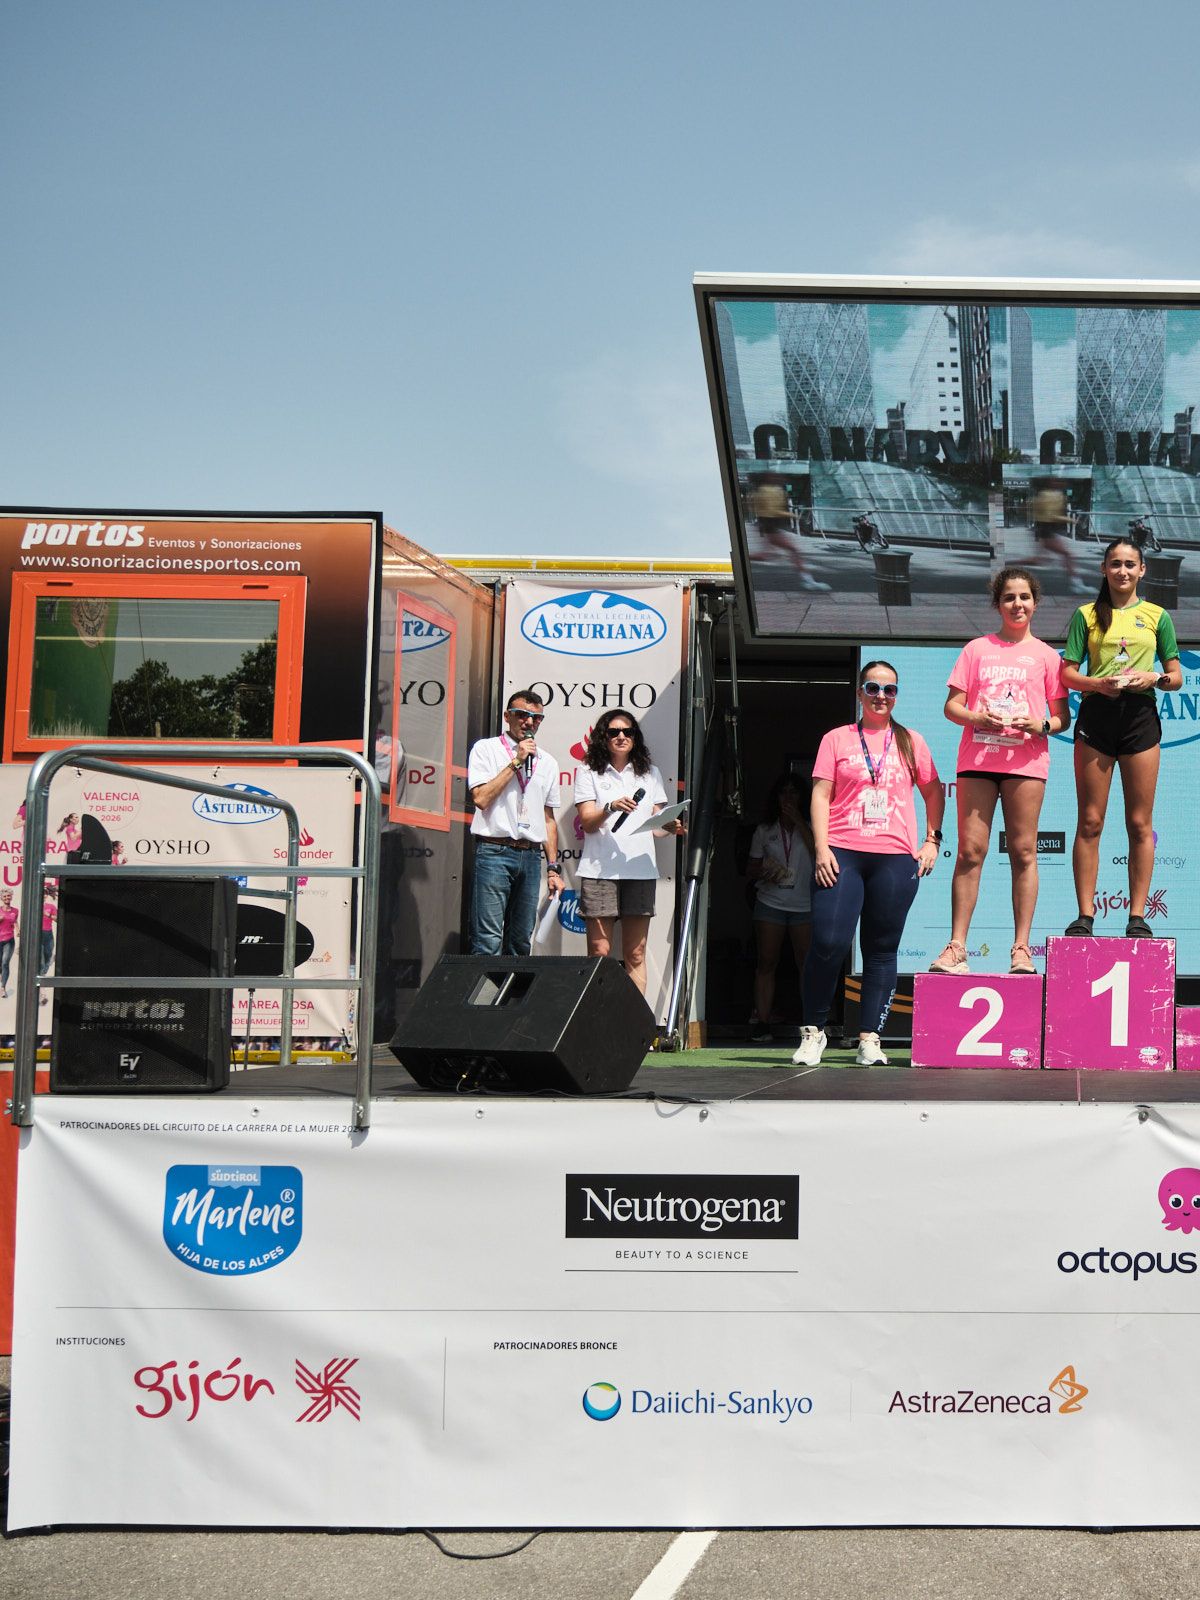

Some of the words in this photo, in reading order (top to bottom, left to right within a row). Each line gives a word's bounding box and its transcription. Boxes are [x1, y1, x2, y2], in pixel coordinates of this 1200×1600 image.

[753, 424, 974, 464] CANARY
[21, 521, 146, 550] portos
[148, 537, 196, 549] Eventos
[199, 540, 207, 551] y
[210, 538, 302, 550] Sonorizaciones
[20, 555, 301, 572] www.sonorizacionesportos.com
[555, 612, 601, 621] CENTRAL
[605, 613, 652, 622] LECHERA
[531, 613, 656, 640] ASTURIANA
[980, 665, 1027, 682] CARRERA
[527, 681, 657, 709] OYSHO
[83, 792, 140, 802] VALENCIA
[89, 805, 94, 813] 7
[109, 805, 134, 813] JUNIO
[101, 814, 122, 822] 2026
[135, 839, 210, 856] OYSHO
[273, 849, 334, 860] Saander
[81, 1000, 185, 1021] portos
[292, 1001, 315, 1010] OSA
[1091, 961, 1130, 1047] 1
[956, 986, 1004, 1057] 2
[120, 1053, 140, 1071] EV
[60, 1121, 141, 1131] PATROCINADORES
[143, 1123, 160, 1131] DEL
[162, 1123, 205, 1132] CIRCUITO
[207, 1123, 220, 1132] DE
[222, 1123, 233, 1132] LA
[236, 1124, 277, 1132] CARRERA
[280, 1124, 292, 1133] DE
[295, 1124, 306, 1133] LA
[309, 1124, 340, 1133] MUJER
[342, 1124, 364, 1133] 202
[171, 1188, 295, 1247] Marlene
[580, 1187, 783, 1232] Neutrogena
[176, 1243, 201, 1264] HIJA
[203, 1257, 219, 1270] DE
[222, 1260, 246, 1271] LOS
[248, 1245, 284, 1269] ALPES
[615, 1250, 662, 1260] BEAUTY
[666, 1250, 681, 1260] TO
[685, 1251, 693, 1260] A
[697, 1251, 749, 1260] SCIENCE
[1057, 1247, 1198, 1281] octopus
[56, 1337, 126, 1347] INSTITUCIONES
[493, 1341, 578, 1350] PATROCINADORES
[580, 1341, 618, 1350] BRONCE
[133, 1357, 276, 1422] gijón
[631, 1389, 813, 1424] Daiichi-Sankyo
[888, 1390, 1051, 1414] AstraZeneca
